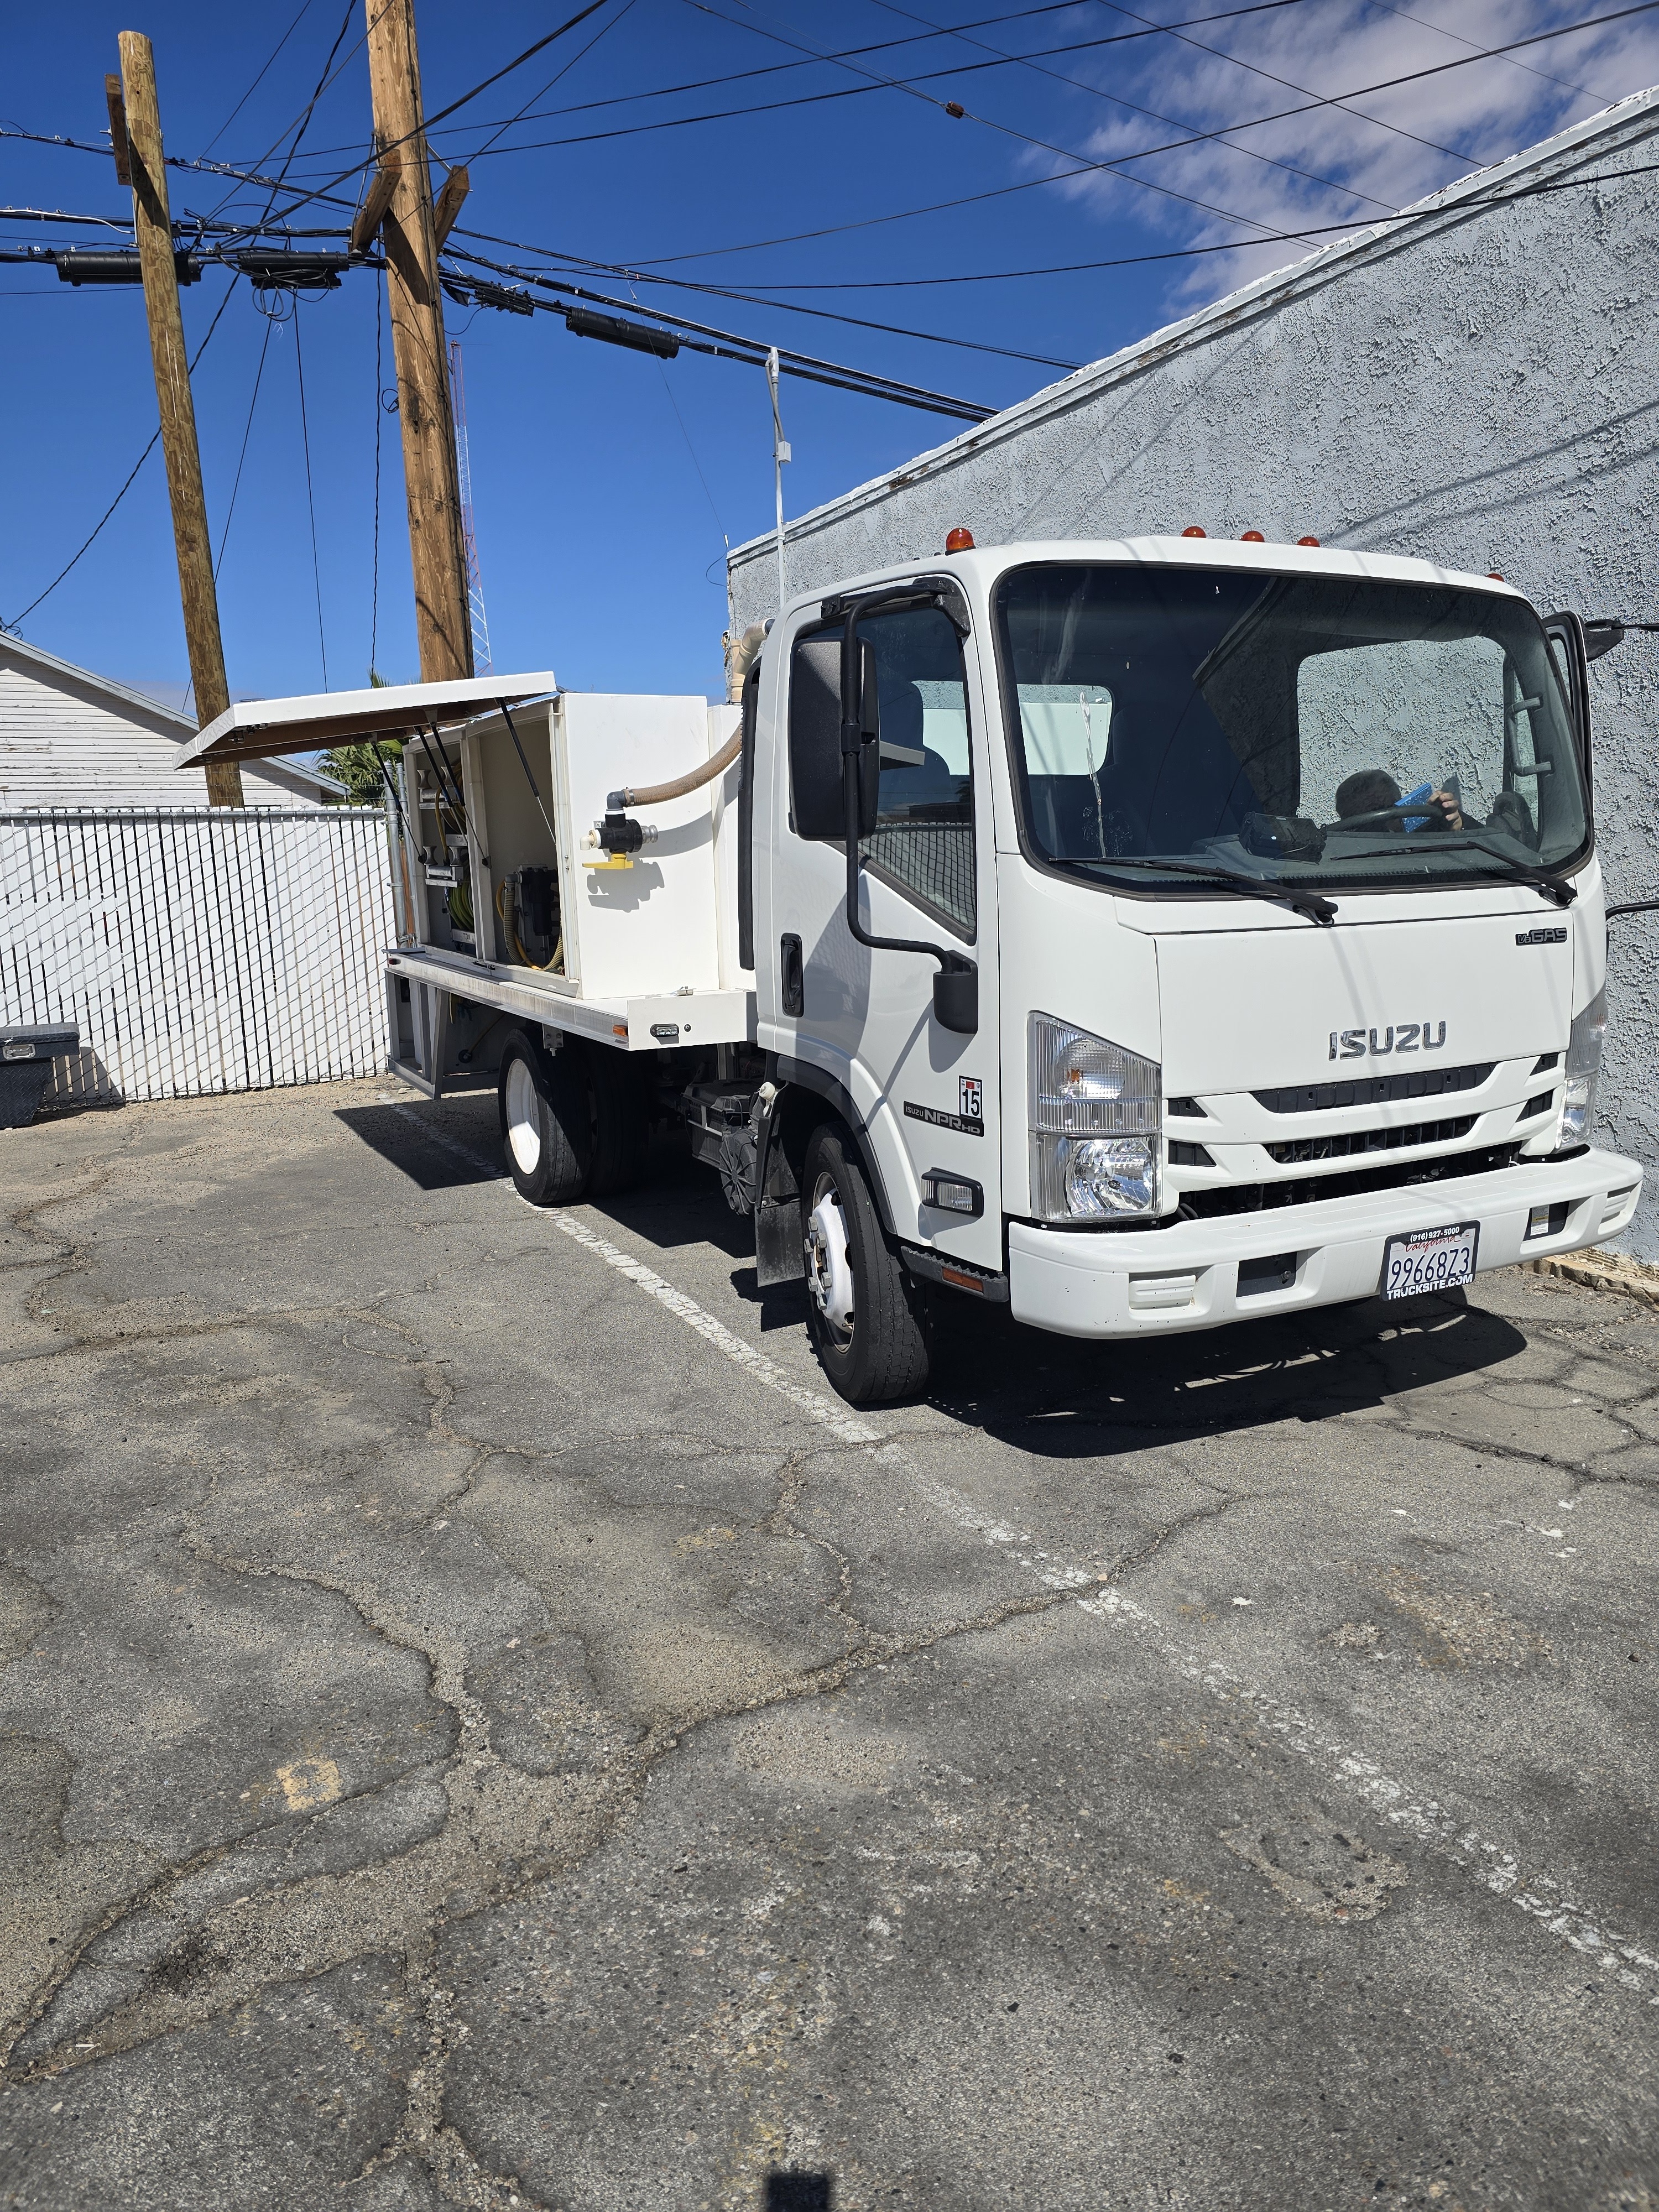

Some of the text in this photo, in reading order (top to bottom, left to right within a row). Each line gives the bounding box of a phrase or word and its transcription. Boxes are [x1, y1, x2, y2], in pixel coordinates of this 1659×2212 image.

[1531, 929, 1566, 942] GAS
[1329, 1021, 1446, 1061] ISUZU
[962, 1089, 979, 1116] 15
[906, 1106, 980, 1134] ISUZU NPR HD
[1390, 1247, 1469, 1289] 99668Z3
[1387, 1274, 1473, 1300] TRUCKSITE.COM
